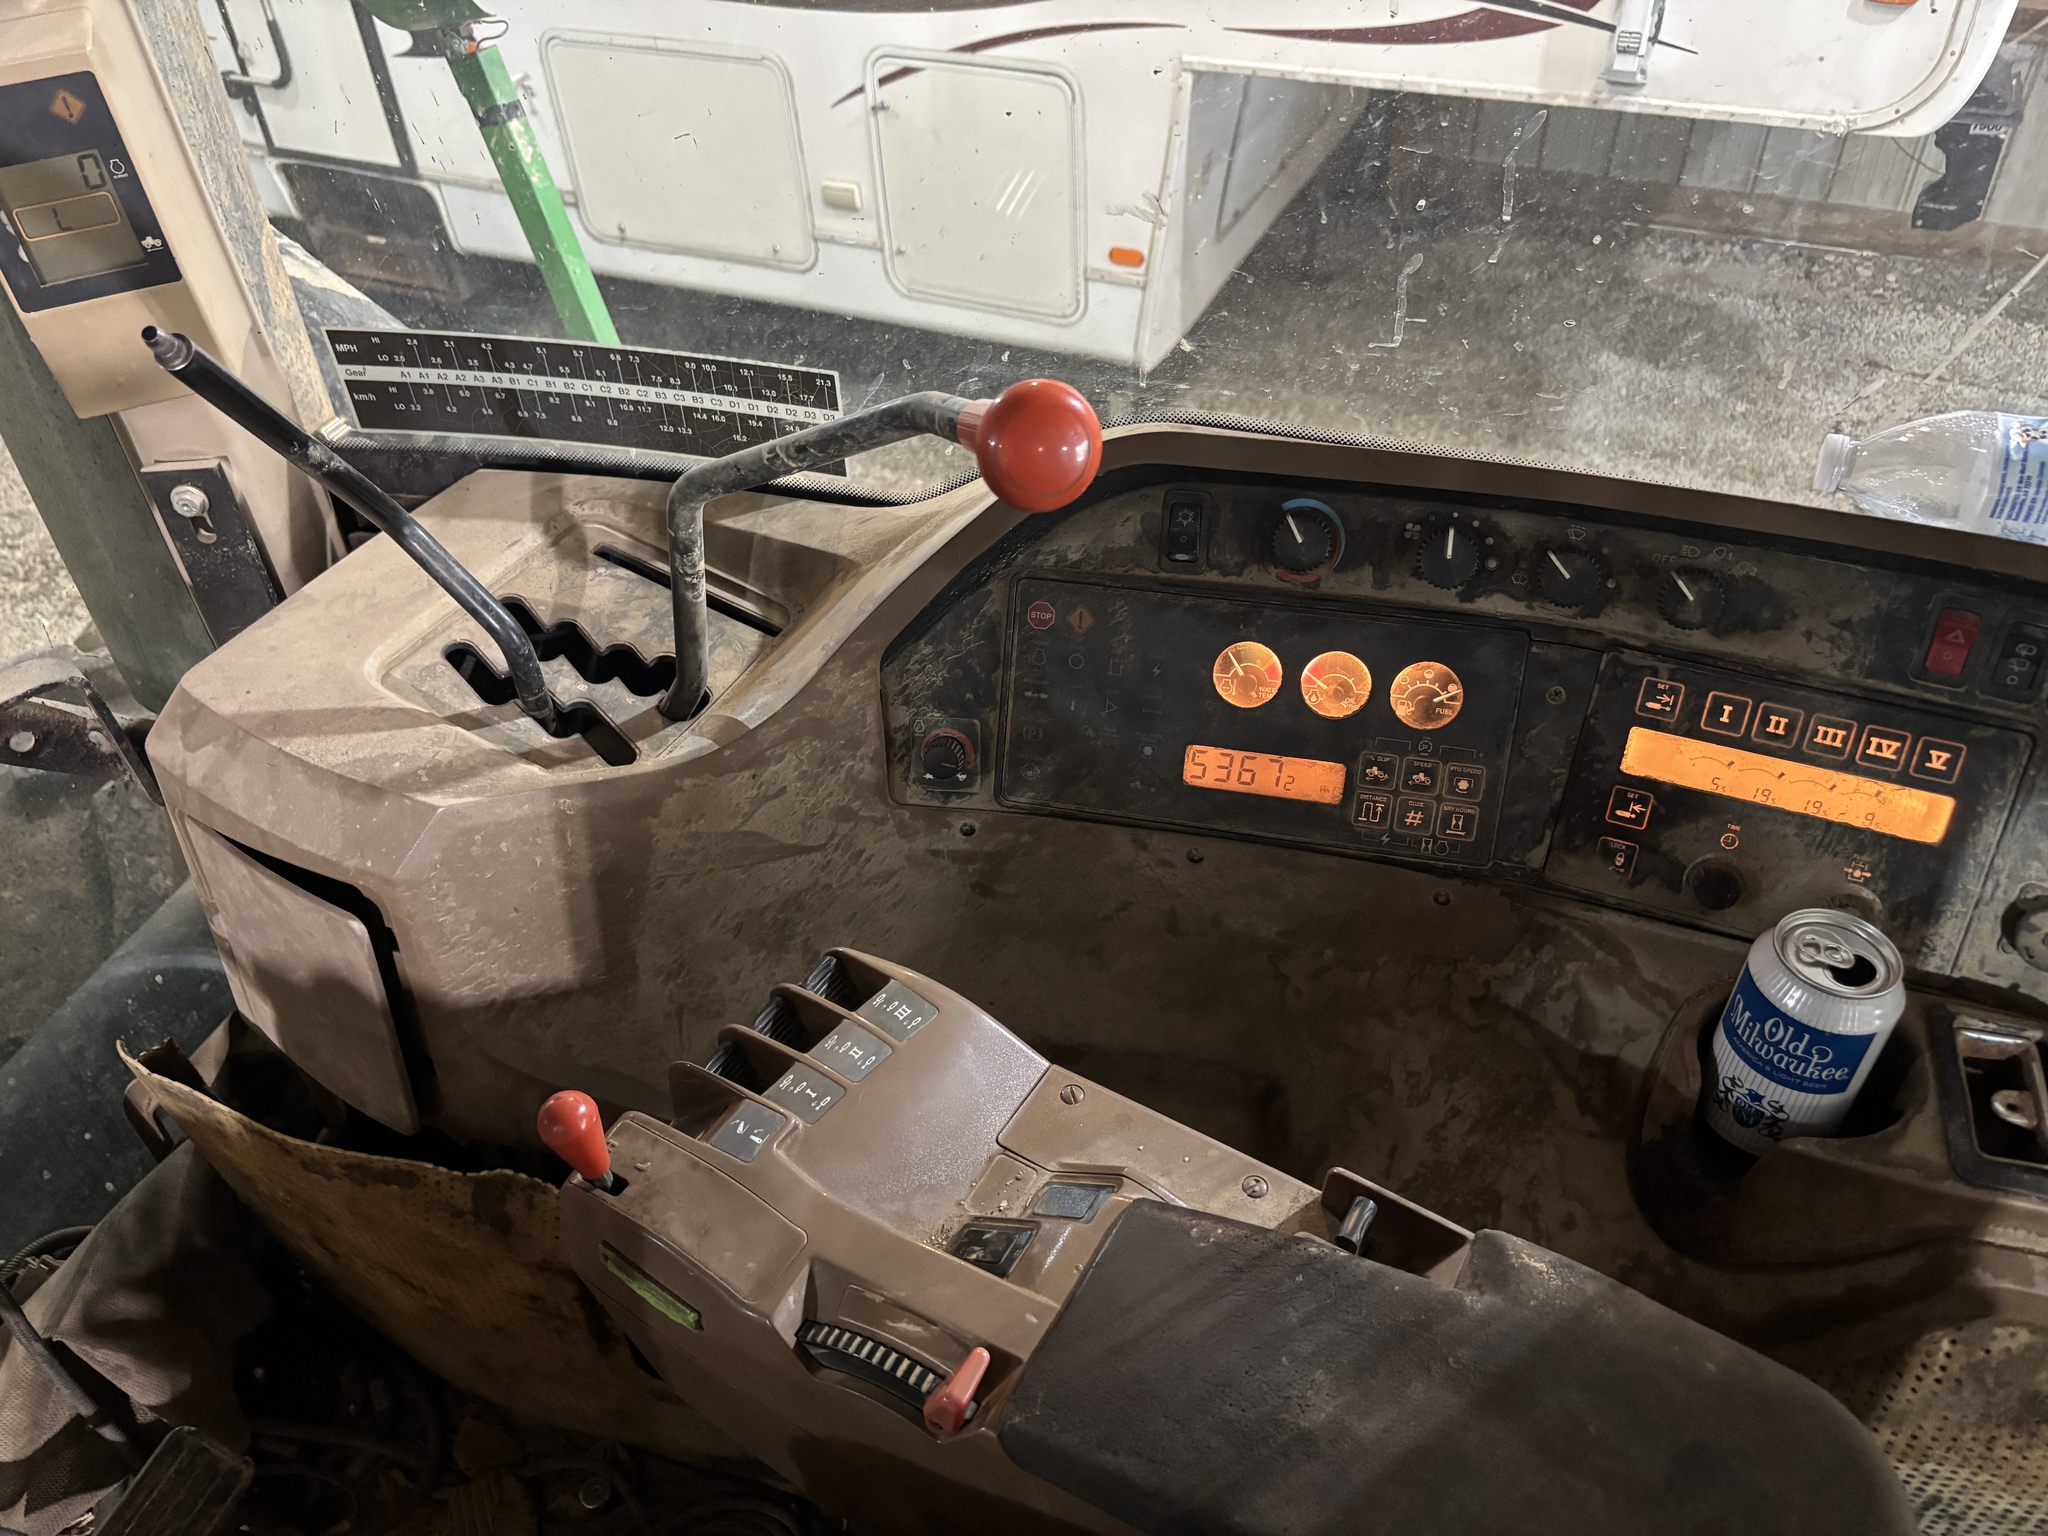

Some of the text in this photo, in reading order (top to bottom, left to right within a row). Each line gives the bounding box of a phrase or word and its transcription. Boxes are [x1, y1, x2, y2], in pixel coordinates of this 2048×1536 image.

[335, 343, 358, 353] MPH
[406, 338, 418, 346] 2.4
[443, 340, 455, 348] 3.1
[628, 355, 640, 363] 7.3
[684, 362, 696, 370] 9.0
[702, 364, 717, 372] 10.0
[778, 374, 793, 382] 15.5
[815, 379, 832, 387] 21.3
[345, 368, 366, 377] Gear
[400, 371, 412, 379] A1
[419, 372, 430, 380] A1
[456, 374, 467, 382] A2
[474, 375, 485, 383] A3
[492, 376, 503, 385] A3
[509, 377, 521, 385] B1
[527, 379, 539, 387] C1
[545, 380, 557, 388] B1
[563, 382, 576, 390] B2
[581, 383, 593, 392] C1
[600, 385, 612, 394] C2
[618, 387, 631, 395] B2
[636, 389, 649, 398] C2
[655, 391, 667, 400] B3
[673, 393, 686, 402] C3
[692, 396, 704, 404] B3
[710, 398, 723, 407] C3
[729, 401, 741, 409] D1
[748, 403, 760, 412] D1
[767, 406, 779, 414] D2
[785, 408, 798, 417] D2
[804, 411, 817, 420] D3
[723, 384, 738, 392] 10.1
[761, 389, 777, 397] 13.0
[353, 392, 377, 401] km/h
[693, 412, 707, 420] 14.4
[659, 425, 674, 433] 12.0
[677, 427, 693, 435] 13.3
[1652, 553, 1677, 564] OFF
[1030, 611, 1052, 620] STOP
[1258, 686, 1279, 694] WATE
[1657, 683, 1670, 691] SET
[1435, 707, 1454, 716] FUEL
[1765, 715, 1789, 736] II
[1813, 725, 1847, 748] III
[1866, 736, 1901, 760] IV
[1924, 749, 1952, 771] V
[1627, 792, 1640, 800] SET
[1610, 842, 1627, 850] LOCK
[1730, 994, 1849, 1080] Milwaukee
[1764, 1017, 1811, 1057] Old
[1773, 1070, 1801, 1084] LIGHT
[1802, 1081, 1827, 1089] BEER
